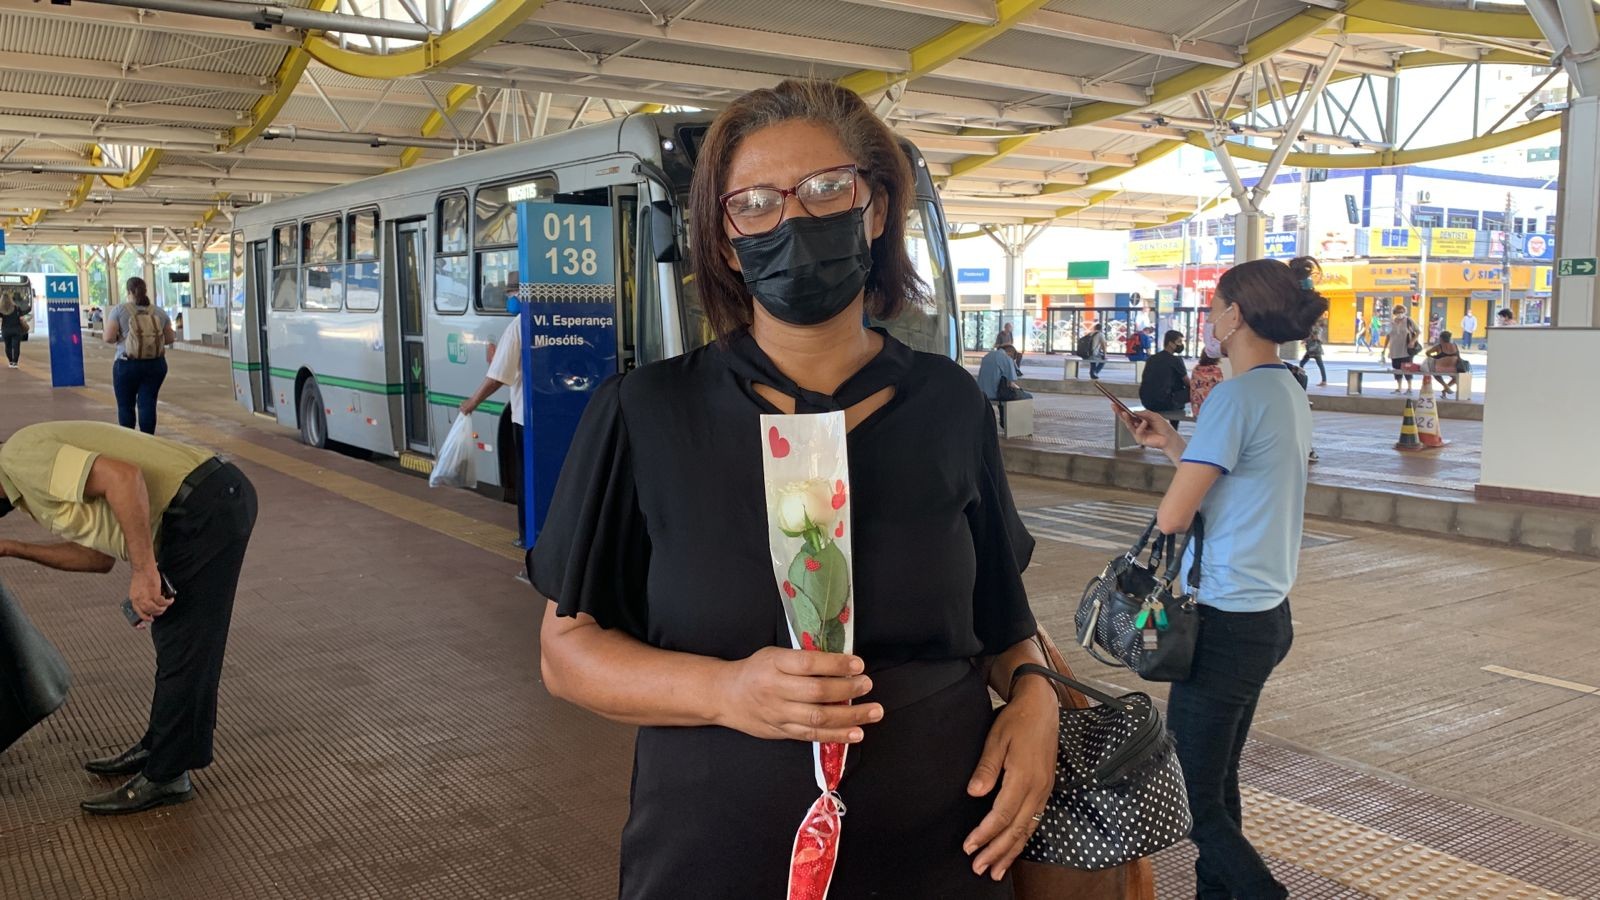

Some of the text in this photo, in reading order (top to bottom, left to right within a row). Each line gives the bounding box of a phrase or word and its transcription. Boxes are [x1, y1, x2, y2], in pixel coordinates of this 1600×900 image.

[543, 212, 592, 242] 011
[1440, 231, 1468, 239] DENTISTA
[1139, 242, 1178, 250] DENTISTA
[545, 247, 598, 276] 138
[50, 281, 74, 293] 141
[552, 315, 613, 328] Esperança
[534, 335, 584, 346] Miosótis
[1417, 417, 1434, 429] 26
